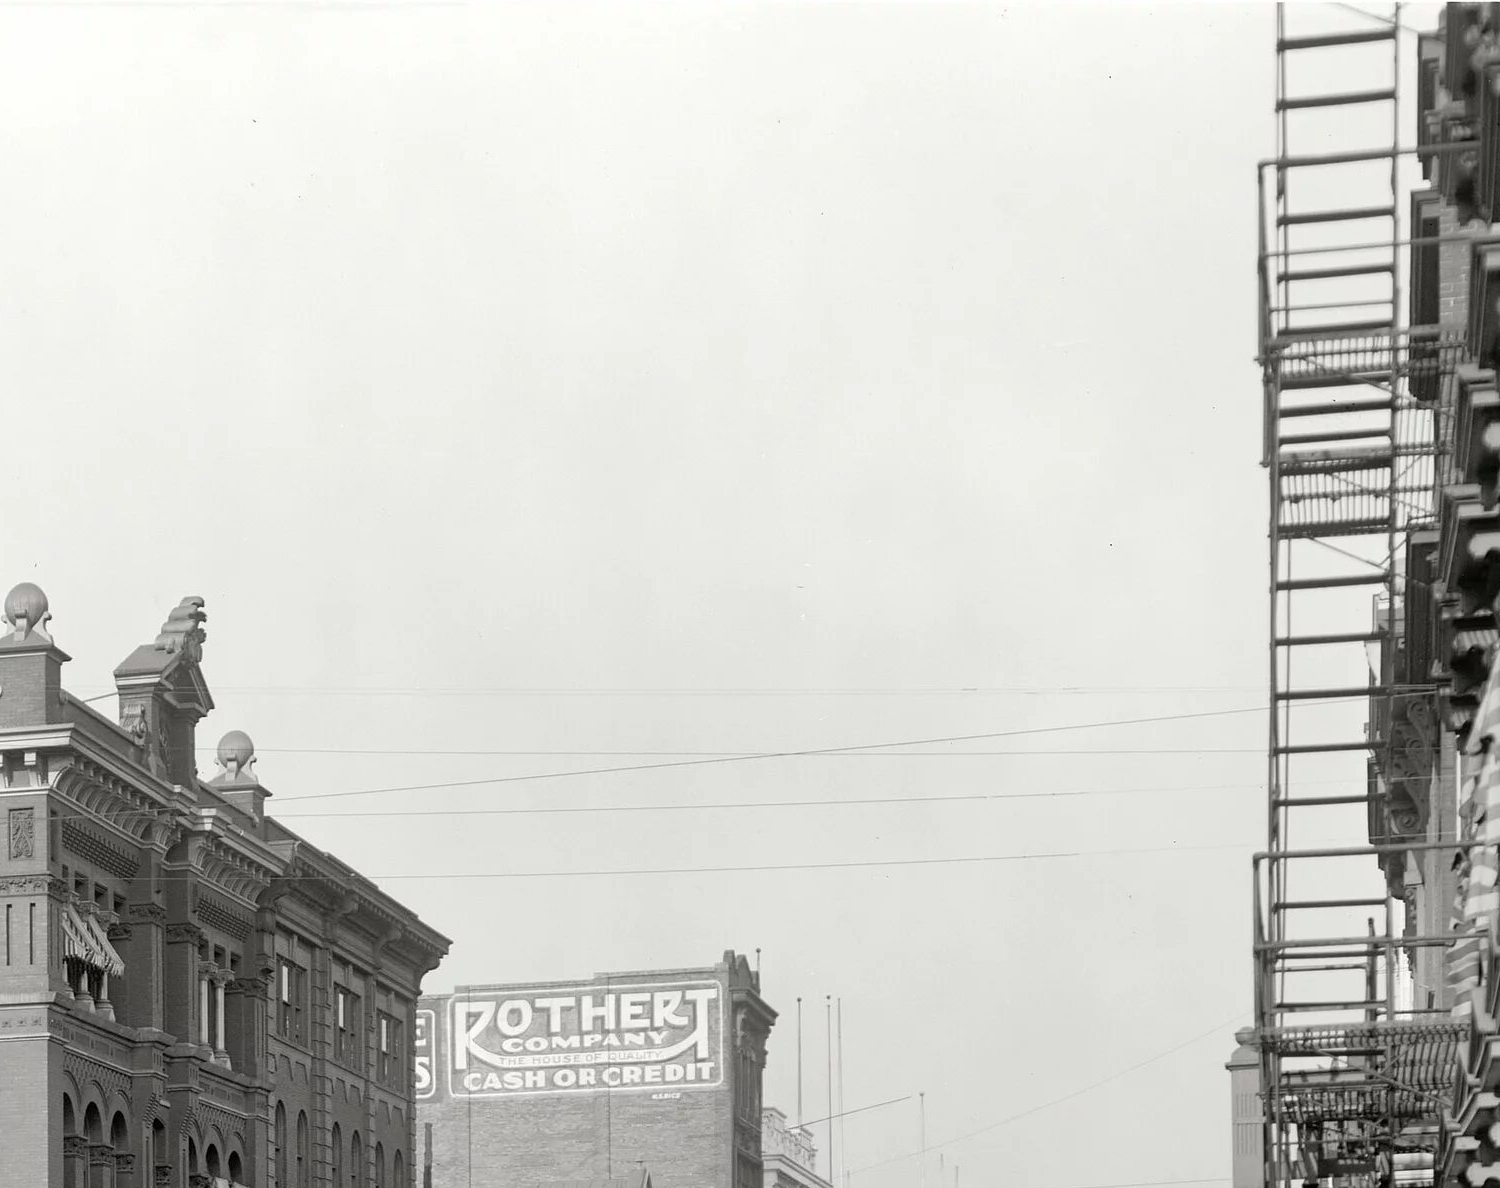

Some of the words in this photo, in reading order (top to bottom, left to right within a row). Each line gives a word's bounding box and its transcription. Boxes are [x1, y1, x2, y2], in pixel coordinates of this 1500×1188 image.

[455, 988, 718, 1069] ROTHERT
[501, 1030, 669, 1052] COMPANY
[500, 1056, 525, 1065] THE
[533, 1055, 580, 1064] HOUSE
[585, 1053, 602, 1062] OF
[608, 1051, 662, 1060] QUALITY
[463, 1069, 546, 1091] CASH
[553, 1067, 597, 1087] OR
[602, 1061, 715, 1087] CREDIT
